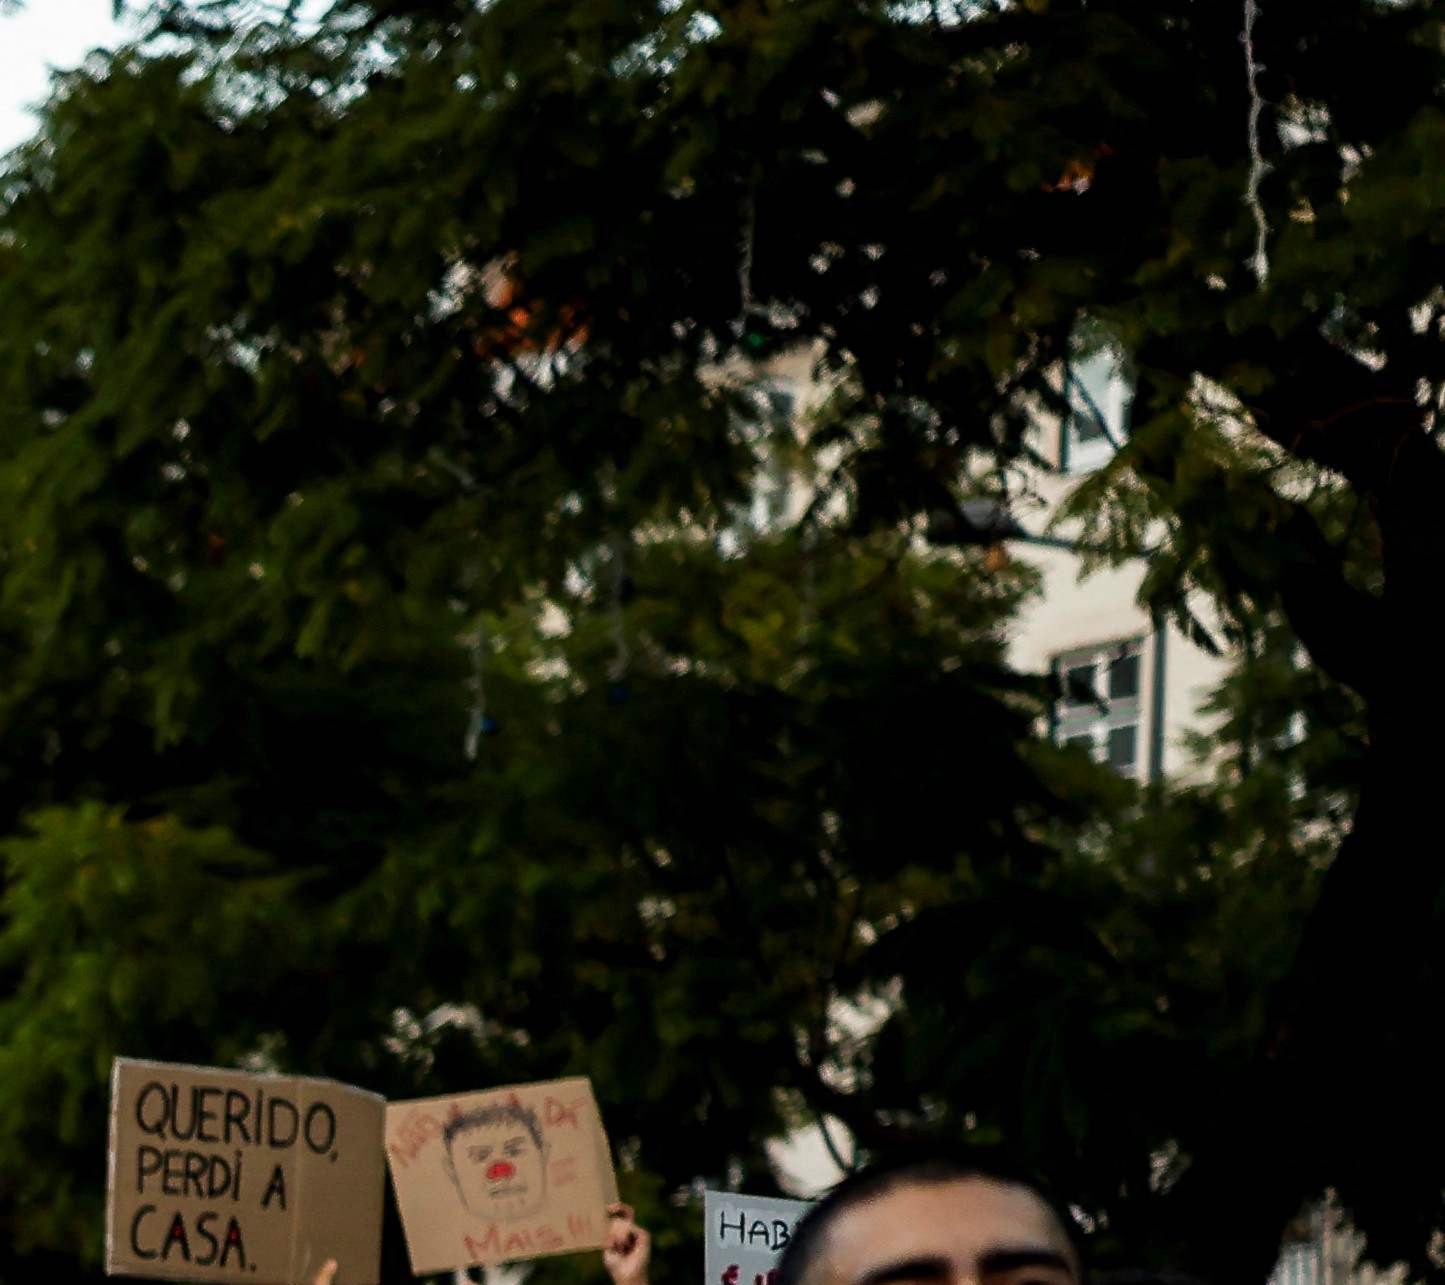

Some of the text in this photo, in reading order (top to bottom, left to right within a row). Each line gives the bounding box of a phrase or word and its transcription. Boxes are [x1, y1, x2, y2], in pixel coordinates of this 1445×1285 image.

[136, 1080, 339, 1163] QUERIDO,
[137, 1145, 287, 1211] PERDI A
[130, 1204, 258, 1273] CASA.
[720, 1210, 792, 1251] HAB
